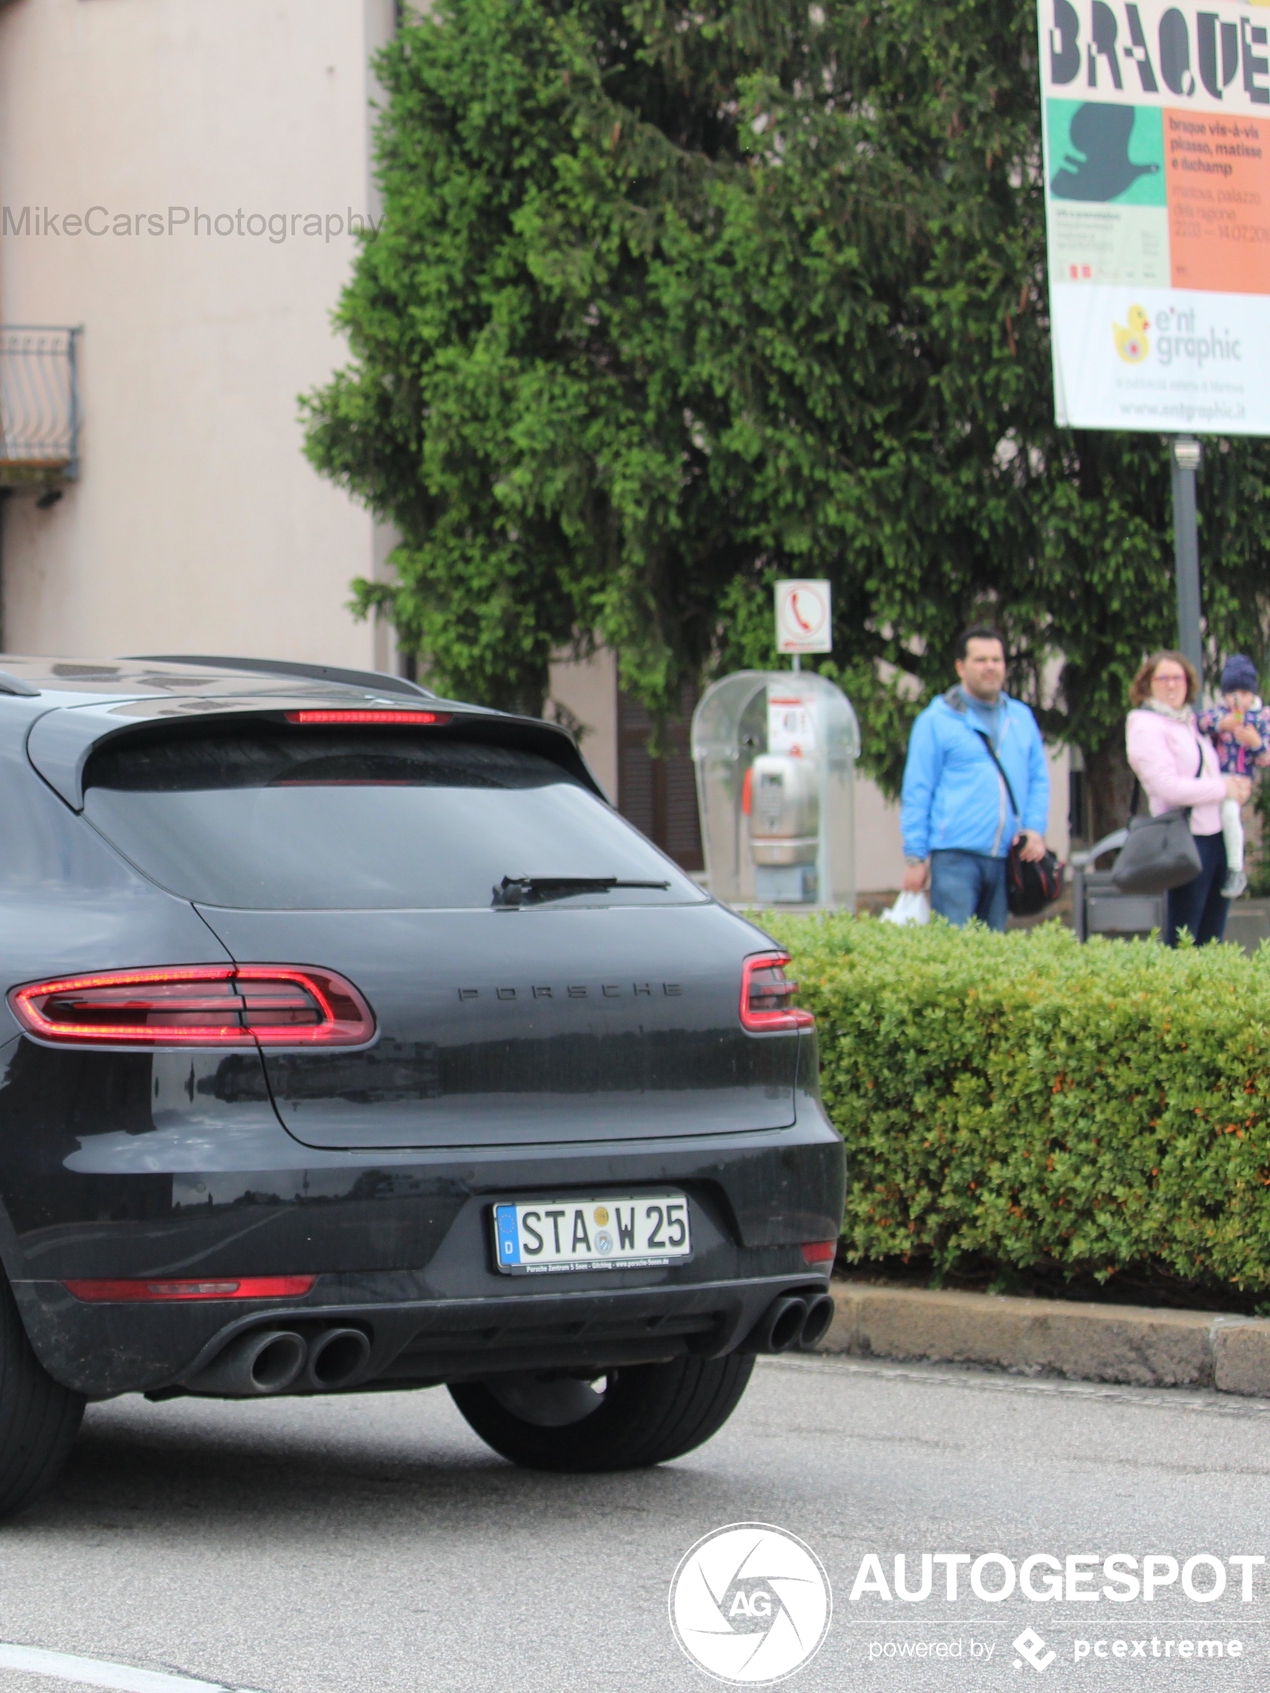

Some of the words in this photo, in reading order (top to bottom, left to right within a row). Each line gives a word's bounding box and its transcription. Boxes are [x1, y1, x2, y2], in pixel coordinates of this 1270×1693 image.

[1049, 0, 1270, 105] BRAQUE
[1215, 142, 1262, 159] matisse
[1182, 157, 1233, 178] duchamp
[1157, 326, 1241, 367] graphic
[458, 982, 682, 1001] PORSCHE
[505, 1241, 514, 1255] D
[522, 1208, 592, 1256] STA
[615, 1207, 636, 1251] W
[646, 1205, 687, 1249] 25
[526, 1264, 547, 1274] Porsche
[548, 1263, 570, 1273] Zentrum
